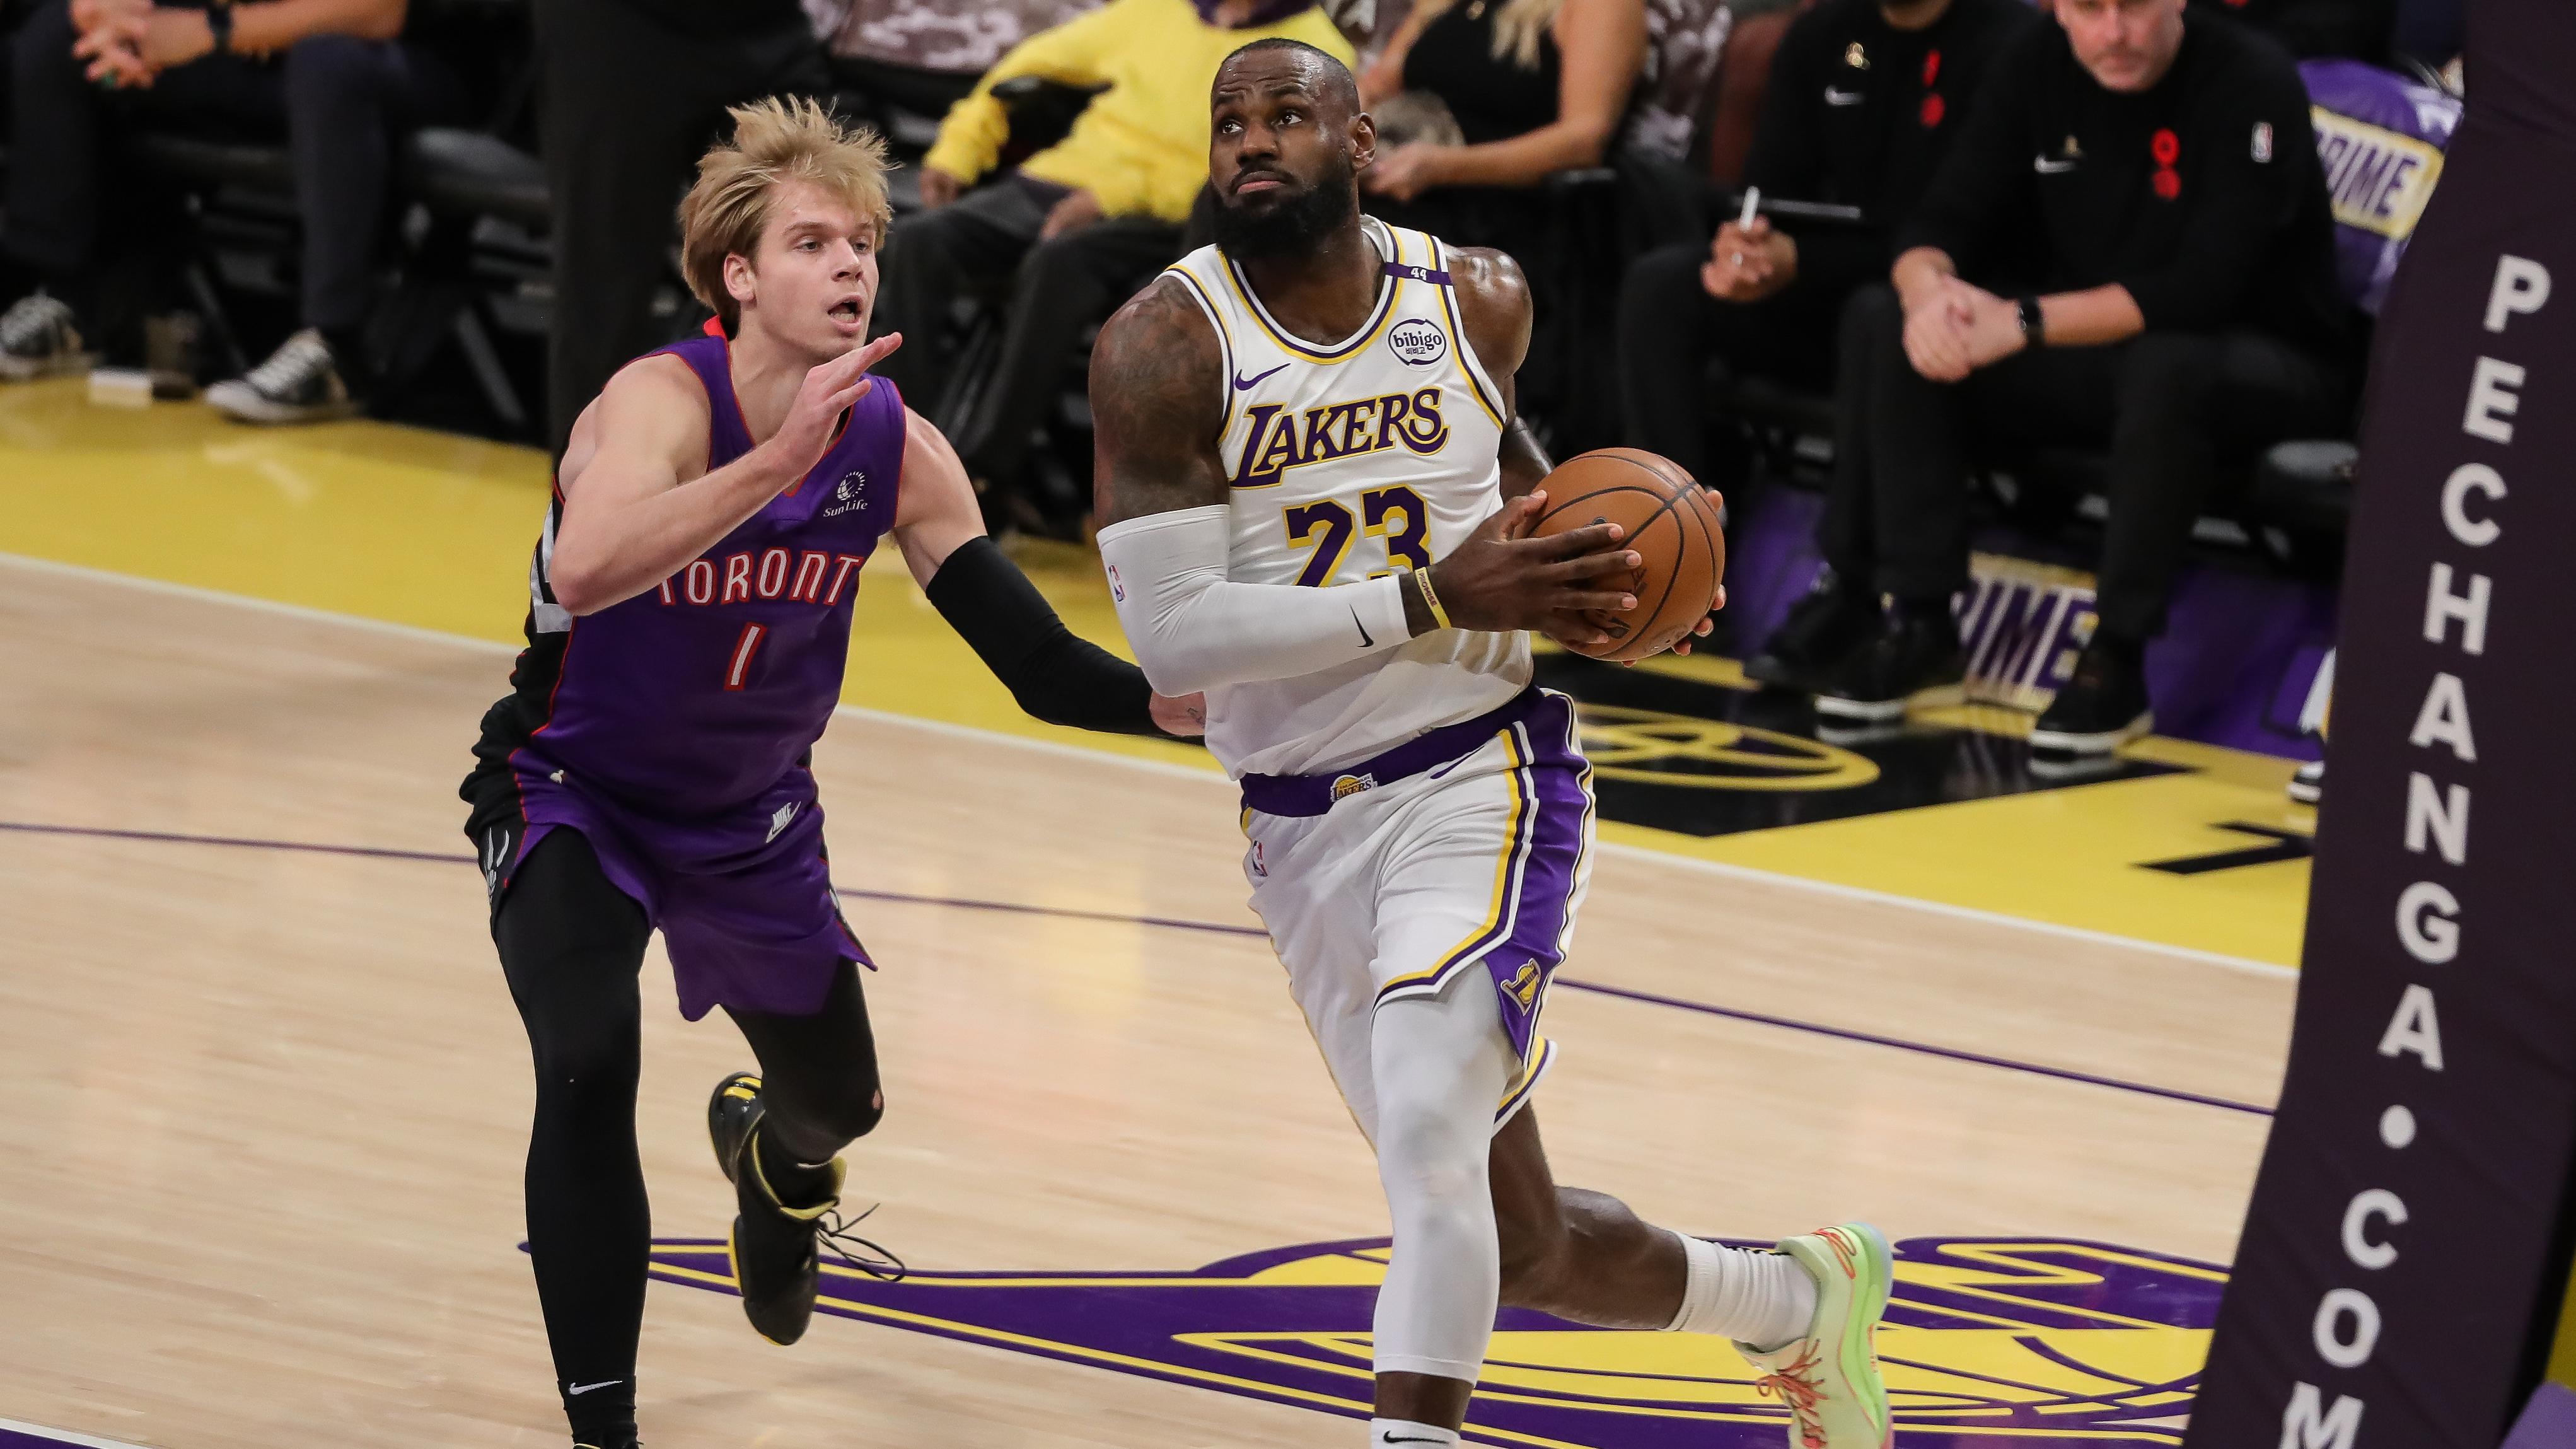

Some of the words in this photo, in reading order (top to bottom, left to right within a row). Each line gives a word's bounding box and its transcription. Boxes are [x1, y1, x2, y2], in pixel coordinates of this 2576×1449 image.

[1410, 267, 1427, 282] 44
[1393, 330, 1442, 351] bibigo
[1229, 385, 1450, 490] LAKERS
[1282, 483, 1434, 588] 23
[726, 622, 765, 690] 1
